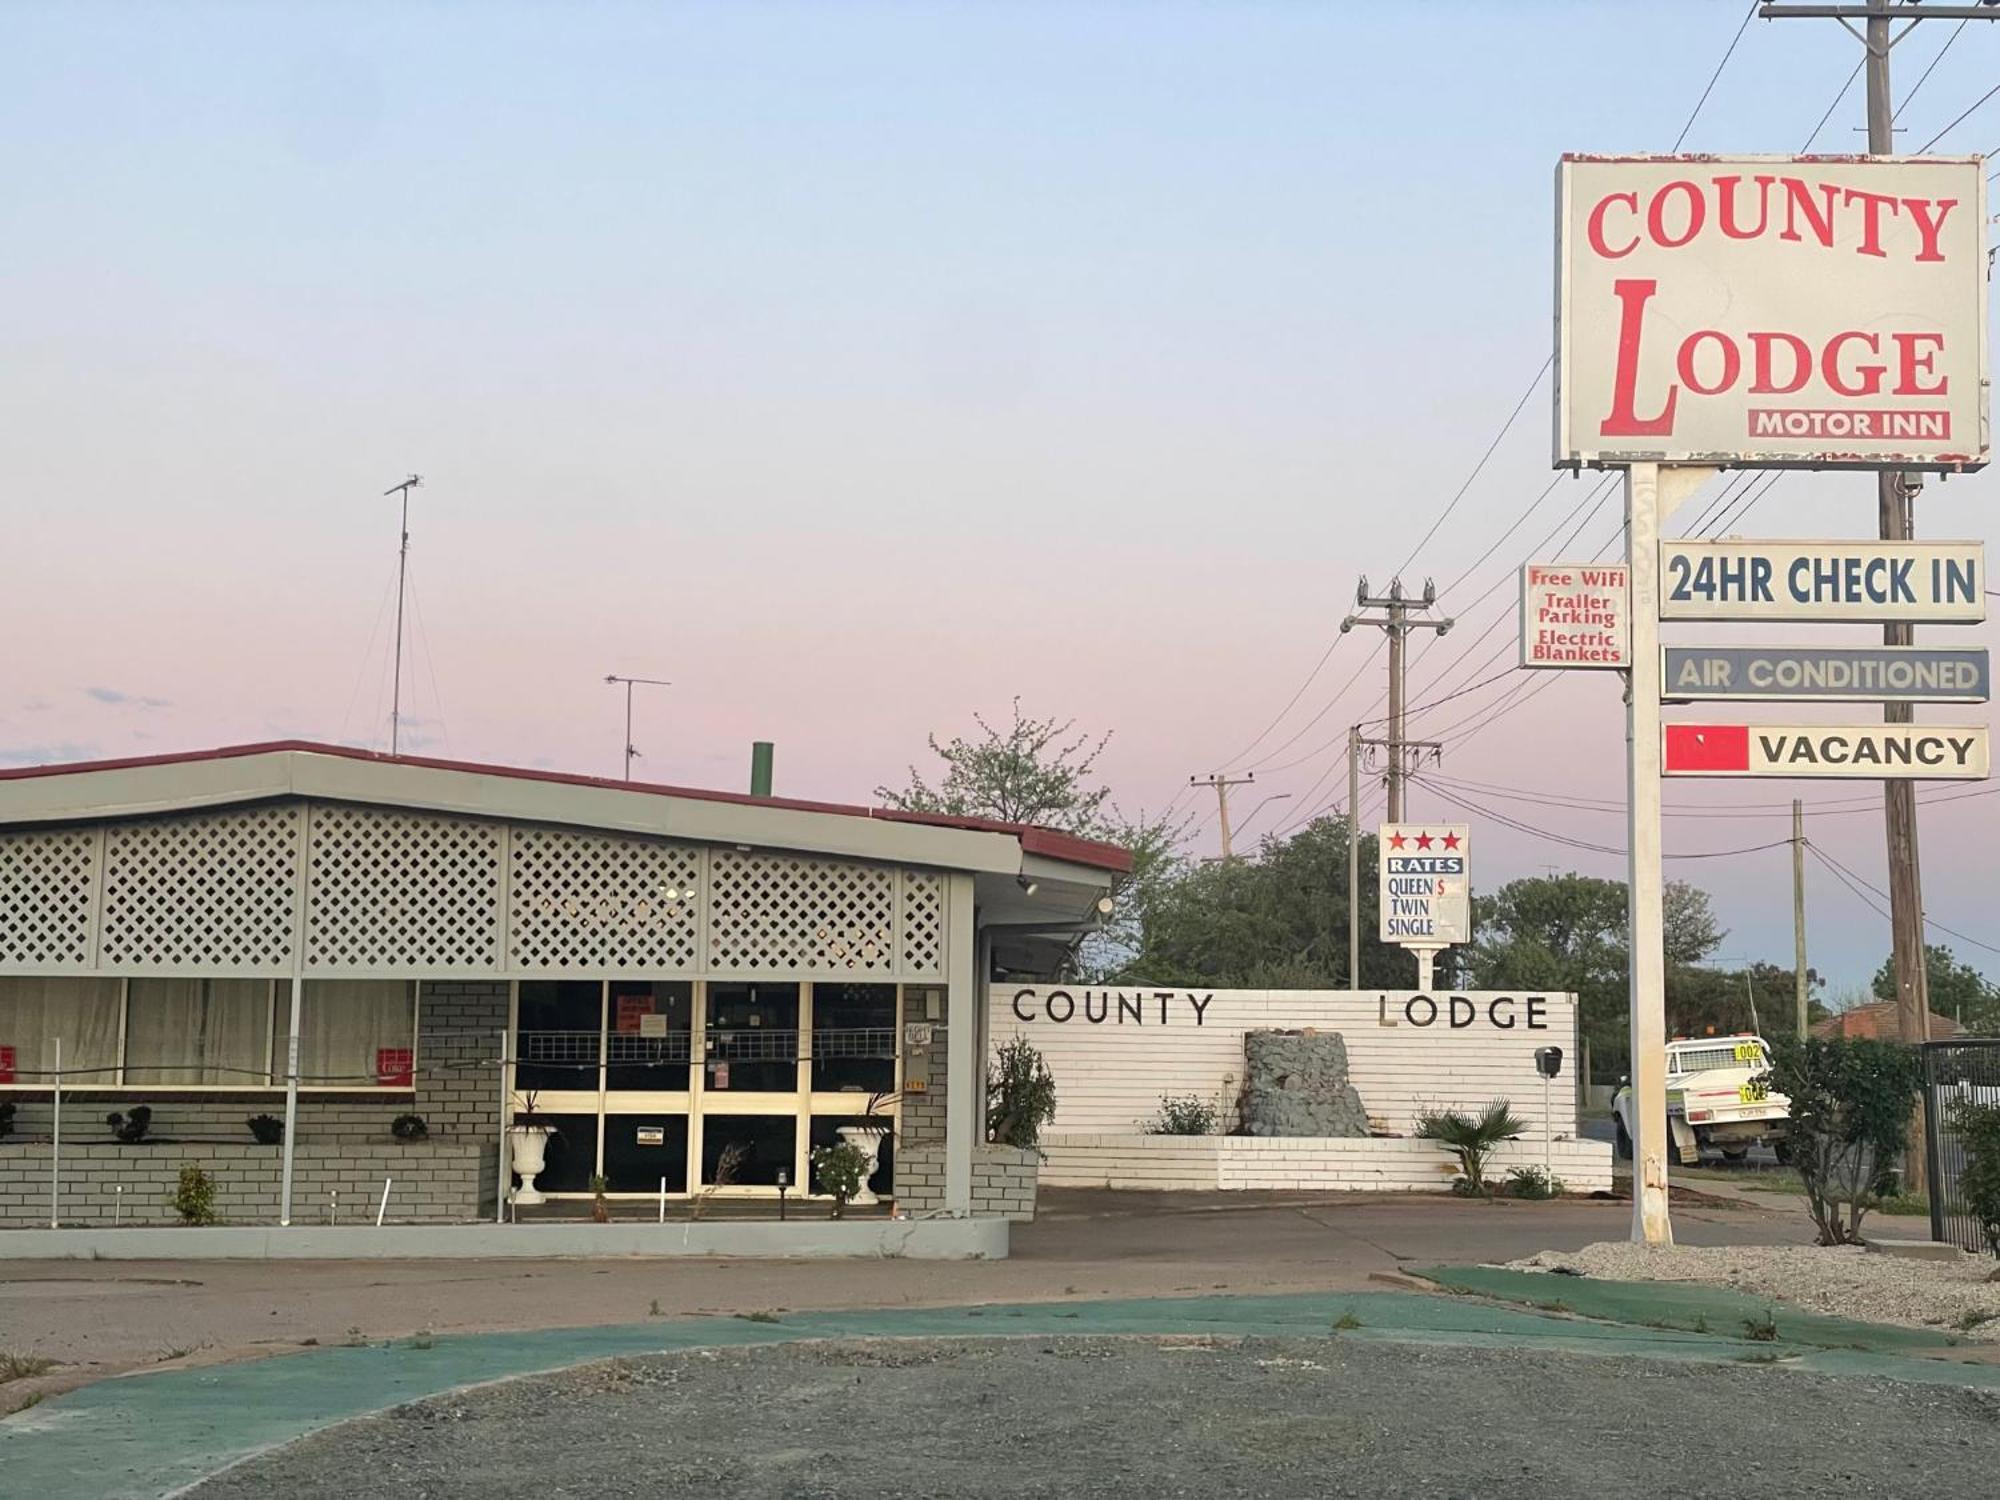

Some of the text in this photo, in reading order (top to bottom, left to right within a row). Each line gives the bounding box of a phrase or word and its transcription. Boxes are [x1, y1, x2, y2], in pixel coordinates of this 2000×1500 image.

[1588, 175, 1958, 262] COUNTY
[1599, 279, 1949, 437] LODGE
[1756, 413, 1944, 436] MOTOR INN
[1531, 570, 1624, 588] Free WiFi
[1669, 554, 1976, 604] 24HR CHECK IN
[1544, 592, 1611, 609] Trailer
[1538, 608, 1616, 629] Parking
[1538, 629, 1615, 646] Electric
[1533, 645, 1621, 662] Blankets
[1677, 658, 1979, 690] AIR CONDITIONED
[1758, 735, 1975, 765] VACANCY
[1390, 859, 1460, 872] RATES
[1388, 878, 1434, 898] QUEEN
[1391, 899, 1429, 916] TWIN
[1388, 918, 1434, 936] SINGLE
[1012, 988, 1548, 1029] COUNTY LODGE
[1740, 1044, 1761, 1058] 002
